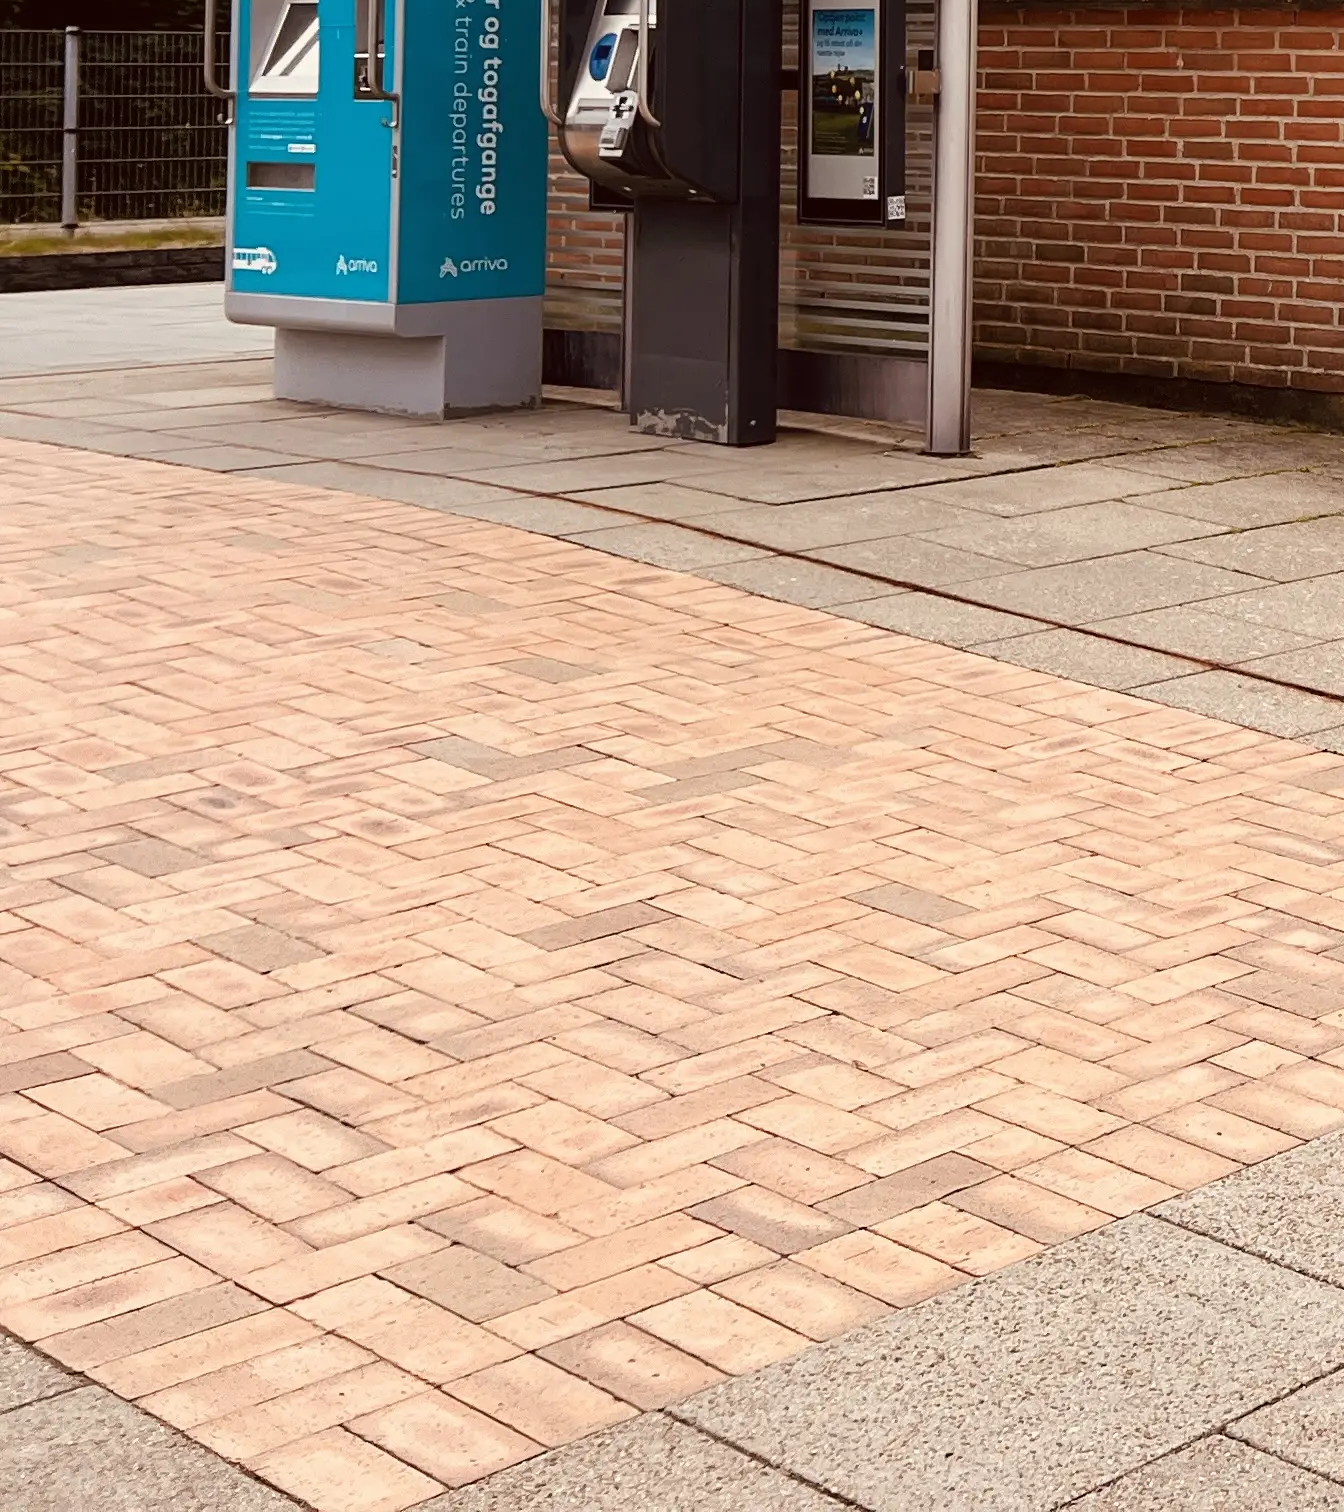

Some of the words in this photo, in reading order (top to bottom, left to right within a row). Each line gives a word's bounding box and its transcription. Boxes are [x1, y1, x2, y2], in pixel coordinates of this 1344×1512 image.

[454, 16, 473, 74] train
[479, 16, 500, 49] og
[448, 82, 473, 219] departures
[475, 56, 504, 215] togafgange
[348, 257, 378, 273] arriva
[460, 256, 509, 273] arriva
